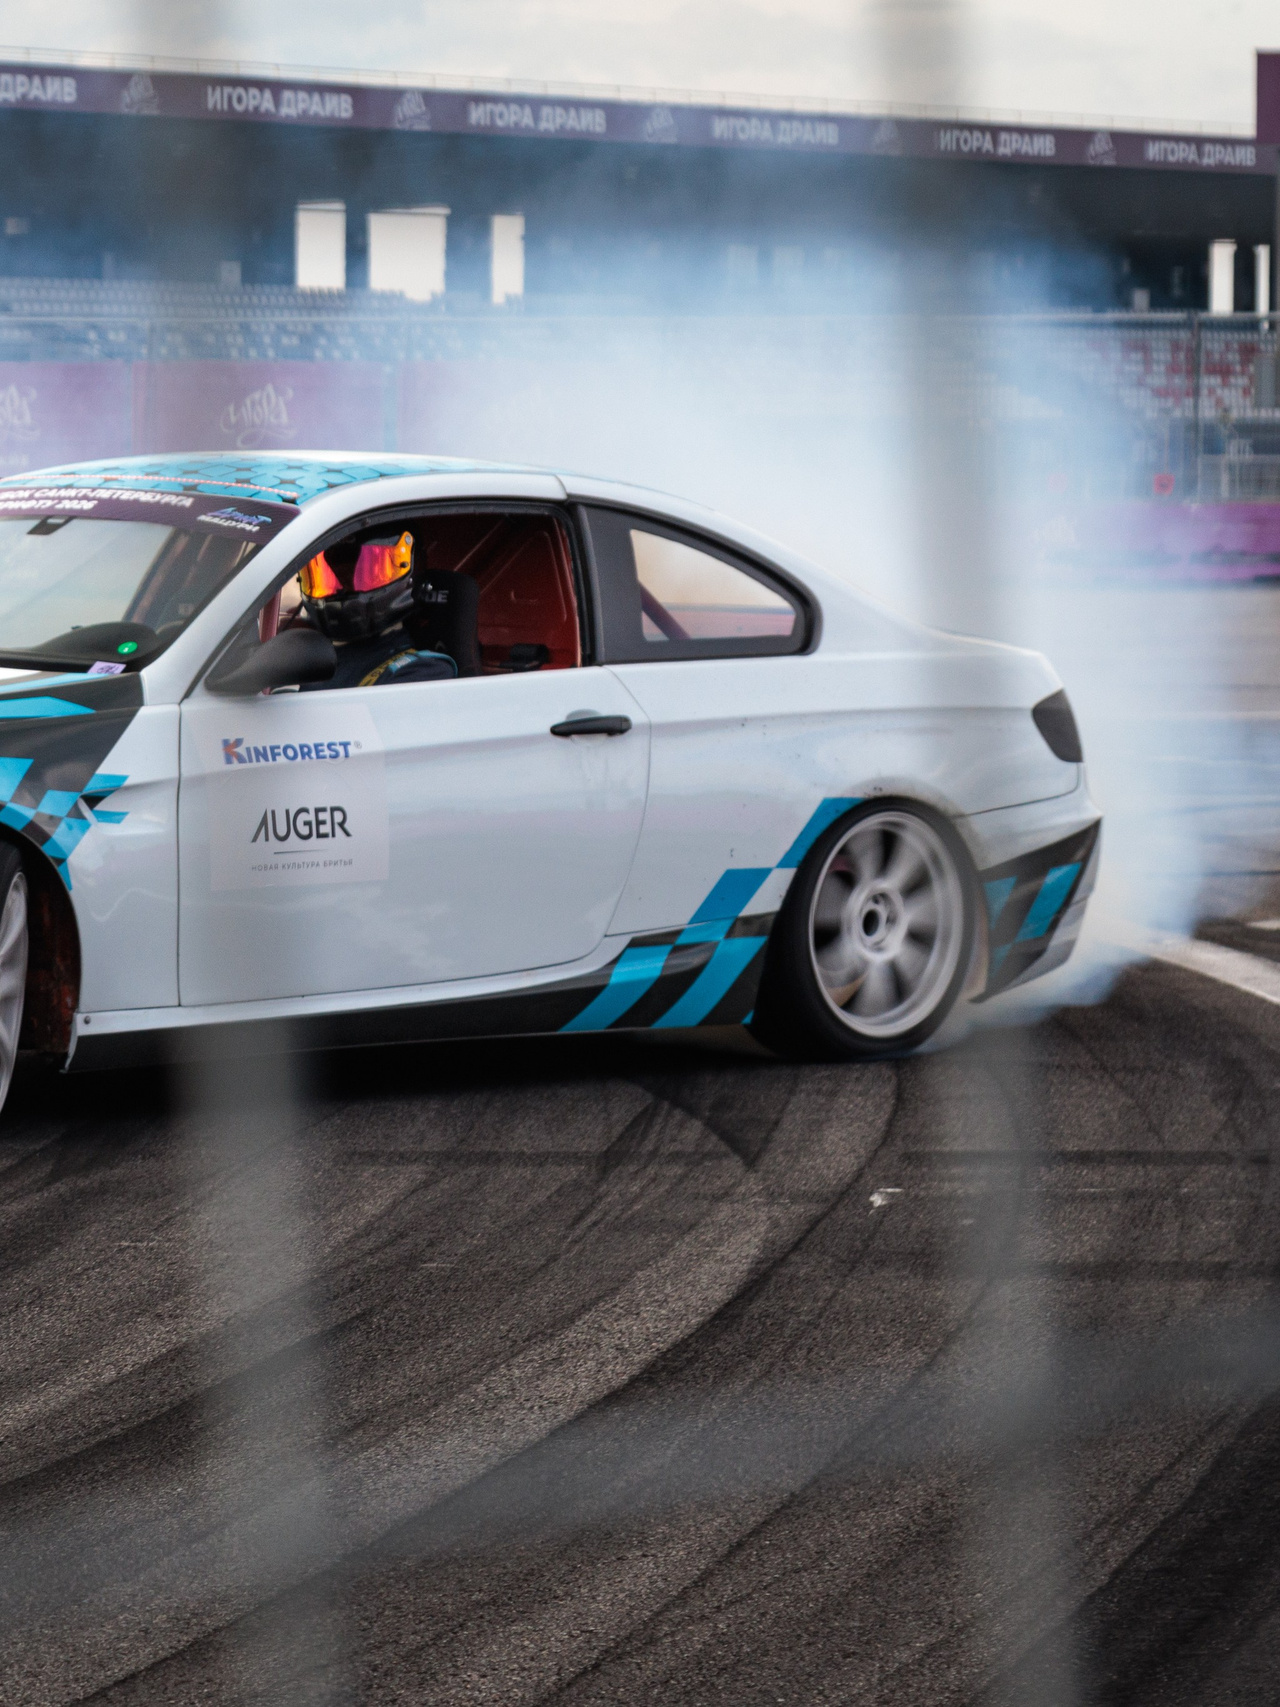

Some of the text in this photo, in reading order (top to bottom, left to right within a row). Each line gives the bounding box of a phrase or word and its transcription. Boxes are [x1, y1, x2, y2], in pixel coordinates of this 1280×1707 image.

[206, 85, 276, 113] ИГОРА
[468, 101, 535, 129] ИГОРА
[939, 129, 995, 154] ИГОРА
[1147, 140, 1200, 164] ИГОРА
[250, 805, 353, 843] AUGER
[251, 859, 353, 872] НОВАЯ КУЛЬТУРА БРИТЬЯ
